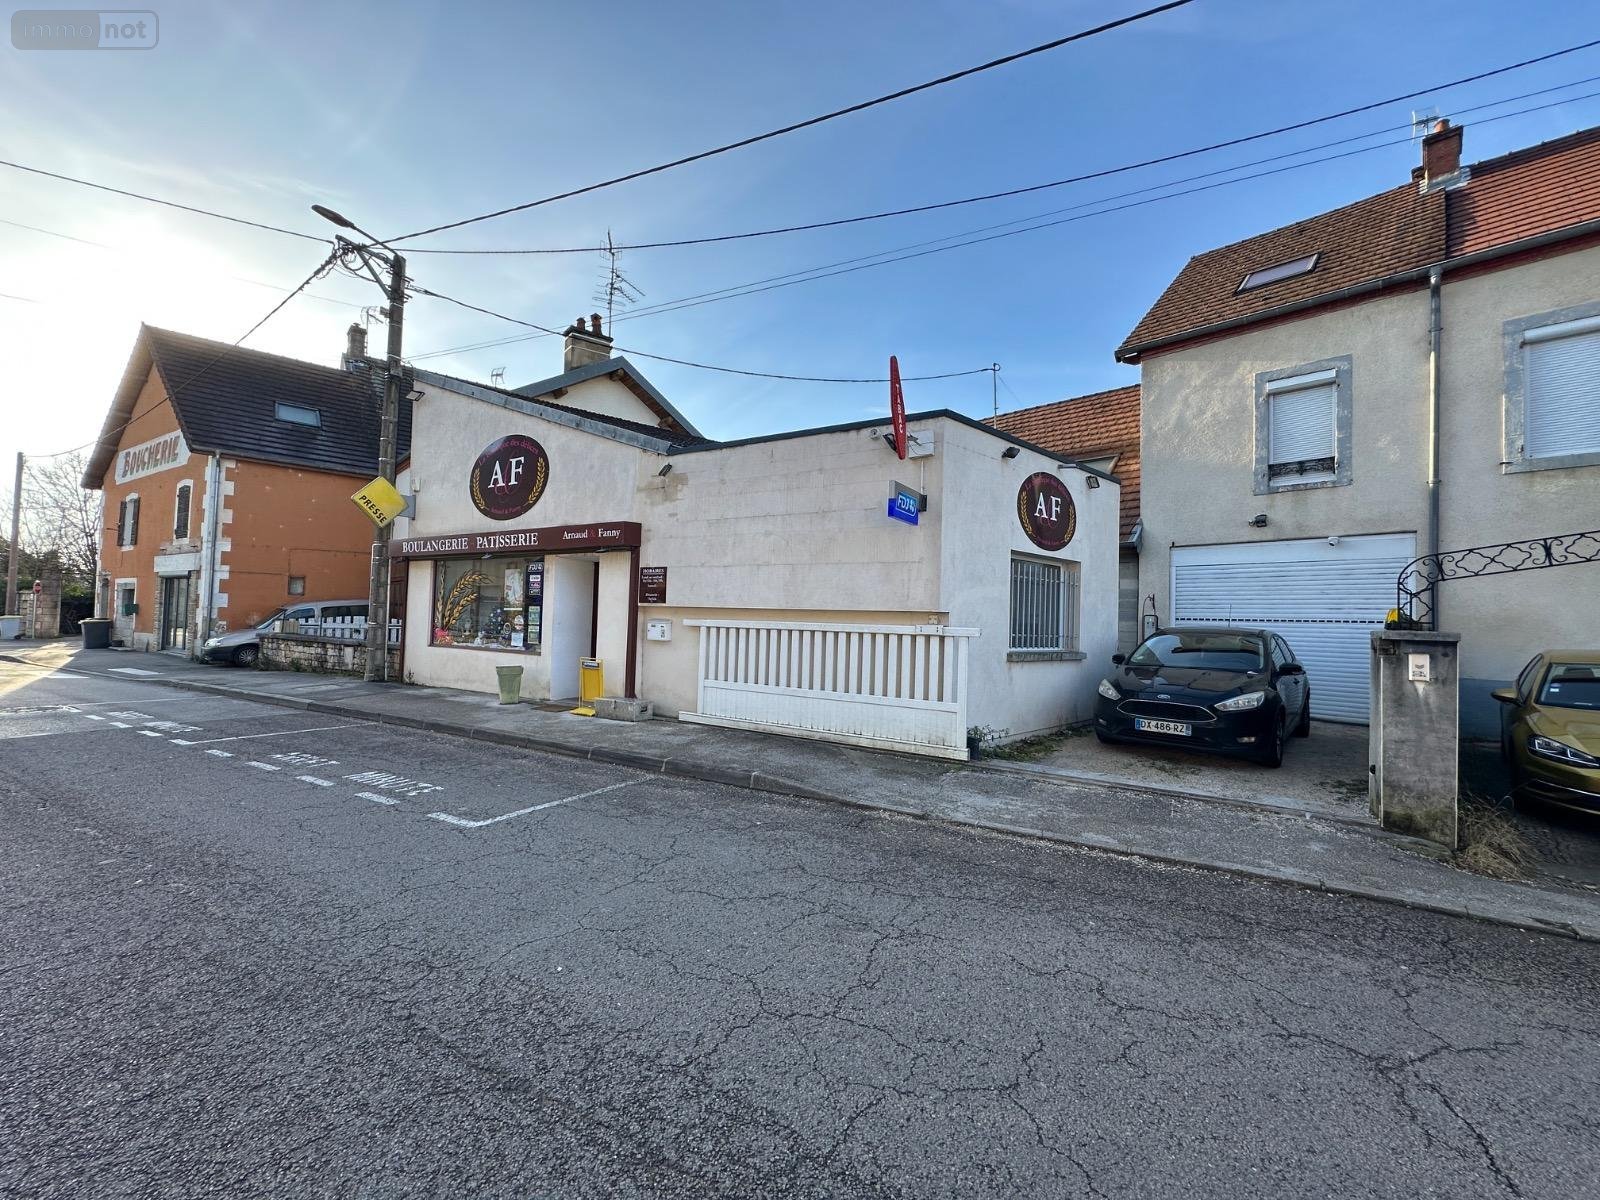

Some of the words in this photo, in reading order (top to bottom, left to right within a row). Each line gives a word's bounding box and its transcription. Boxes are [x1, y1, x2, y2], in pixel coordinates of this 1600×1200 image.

[895, 383, 904, 434] TABAC
[121, 435, 181, 478] BOUCHERIE
[358, 494, 387, 523] PRESSE
[402, 537, 469, 553] BOULANGERIE
[476, 532, 539, 549] PATISSERIE
[562, 529, 588, 540] Arnaud
[598, 528, 621, 539] Fanny
